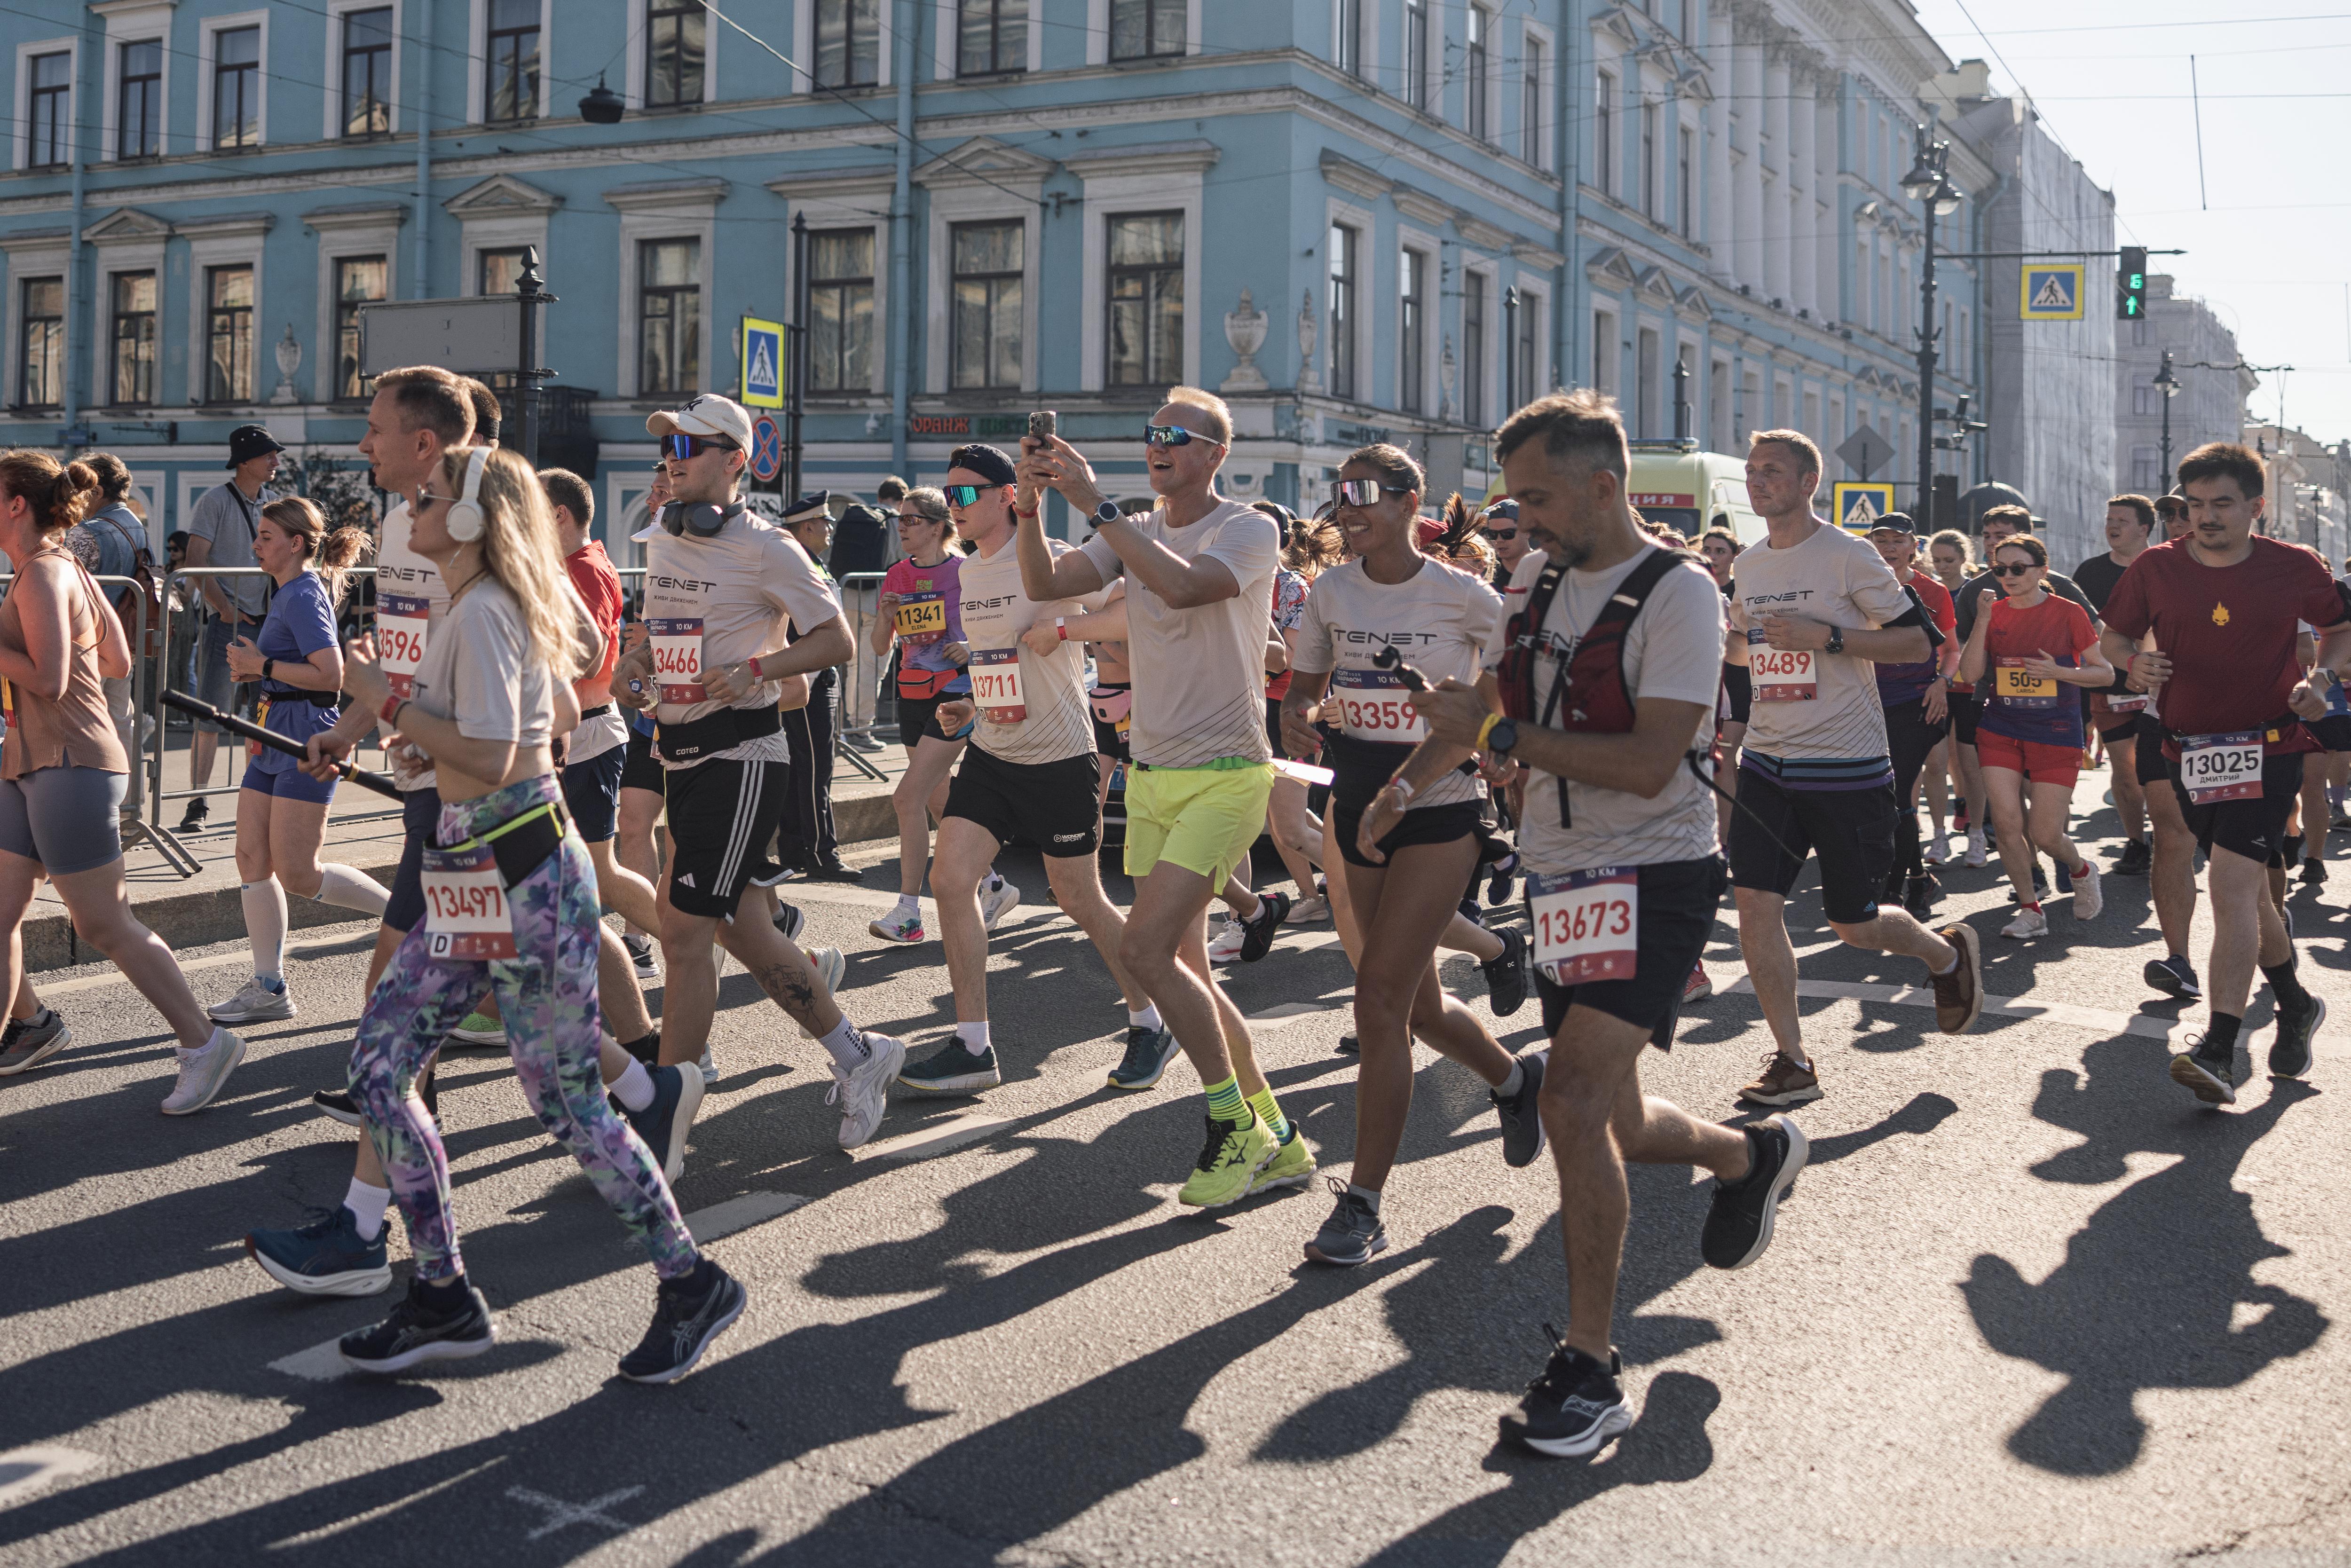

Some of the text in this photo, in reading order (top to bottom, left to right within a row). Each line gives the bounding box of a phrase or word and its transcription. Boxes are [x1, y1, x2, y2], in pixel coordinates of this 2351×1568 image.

[2130, 274, 2143, 289] 6
[913, 417, 969, 433] ОРАНЖ
[376, 566, 435, 583] ENET
[649, 576, 717, 592] TENET
[960, 595, 1017, 611] TENET
[1745, 591, 1814, 606] TENET
[405, 603, 415, 612] KM
[896, 605, 940, 626] 11341
[1334, 629, 1437, 645] TENET
[1750, 652, 1810, 676] 13489
[973, 674, 1017, 698] 13711
[1754, 687, 1759, 699] D
[2004, 697, 2011, 705] D
[1339, 698, 1417, 730] 13359
[1122, 732, 1129, 740] C
[2185, 750, 2258, 776] 13025
[2200, 773, 2240, 784] ДМИТРИЙ
[2189, 790, 2198, 802] D
[1586, 869, 1596, 878] 10
[427, 886, 501, 918] 13497
[1539, 900, 1630, 947] 13673
[434, 935, 447, 953] D
